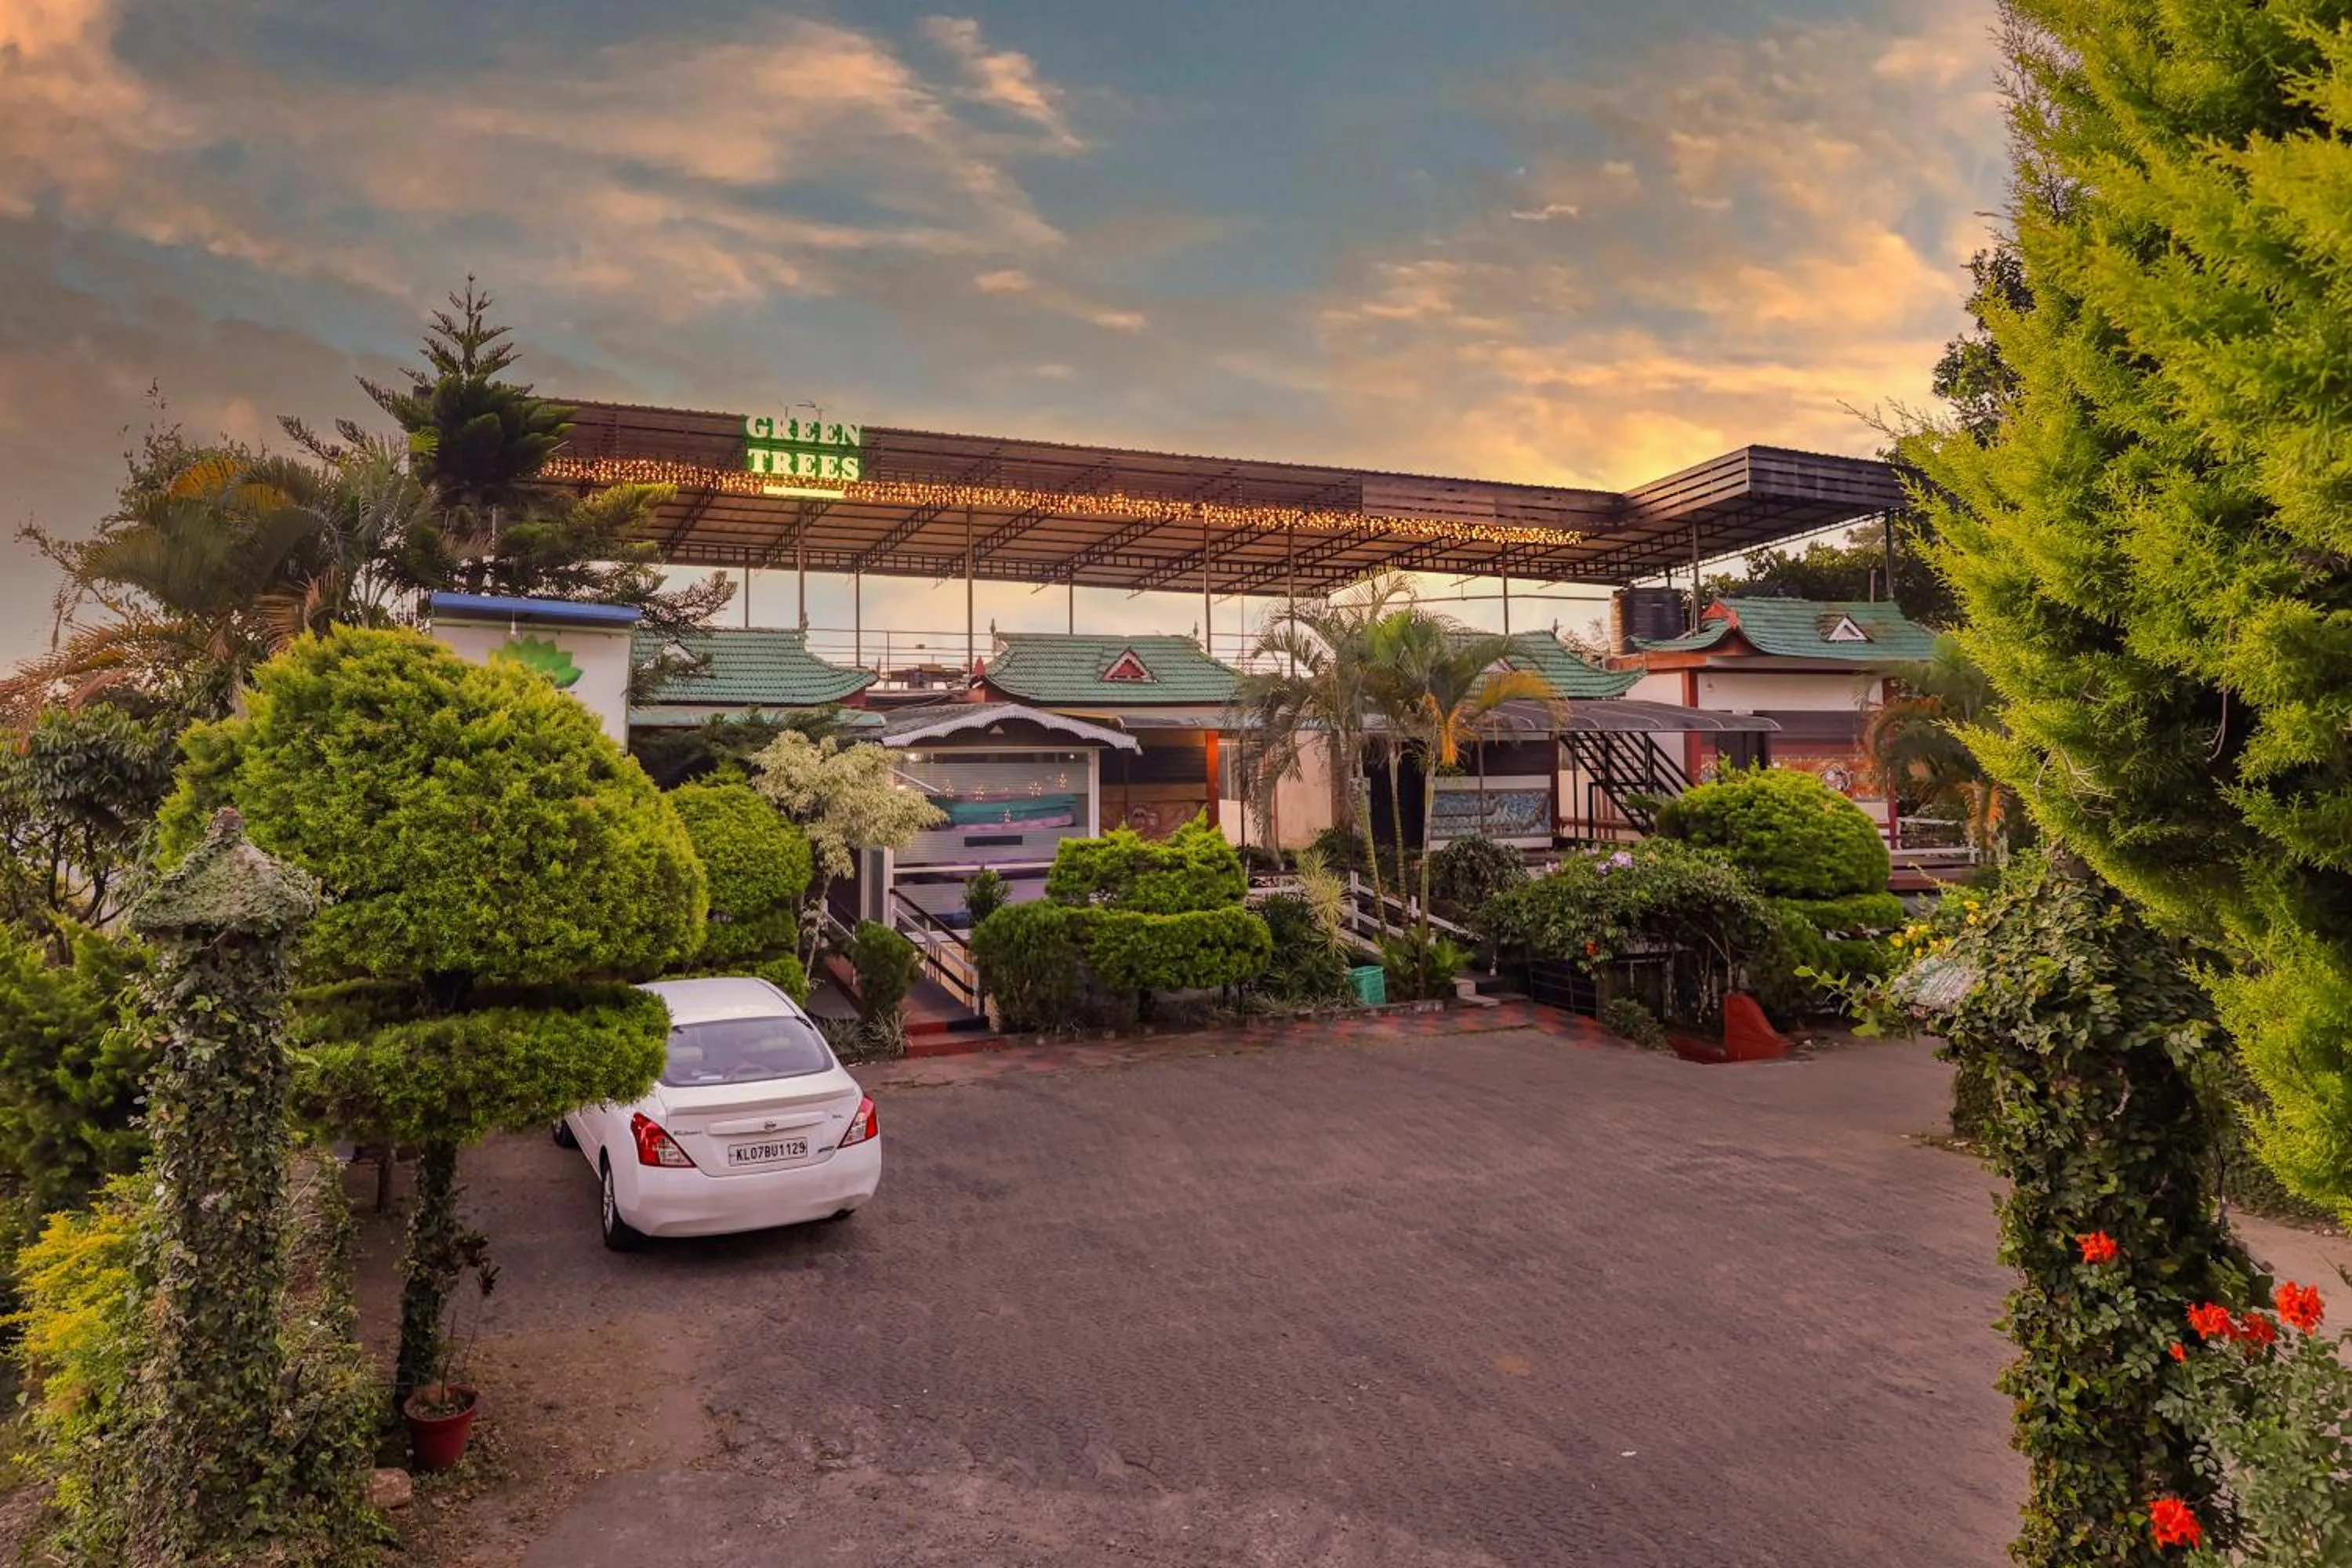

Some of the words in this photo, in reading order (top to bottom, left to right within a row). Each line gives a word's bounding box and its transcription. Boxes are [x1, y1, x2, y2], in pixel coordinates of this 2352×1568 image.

[746, 415, 862, 446] GREEN
[747, 448, 859, 483] TREES
[736, 1142, 806, 1161] KL07BU1129
